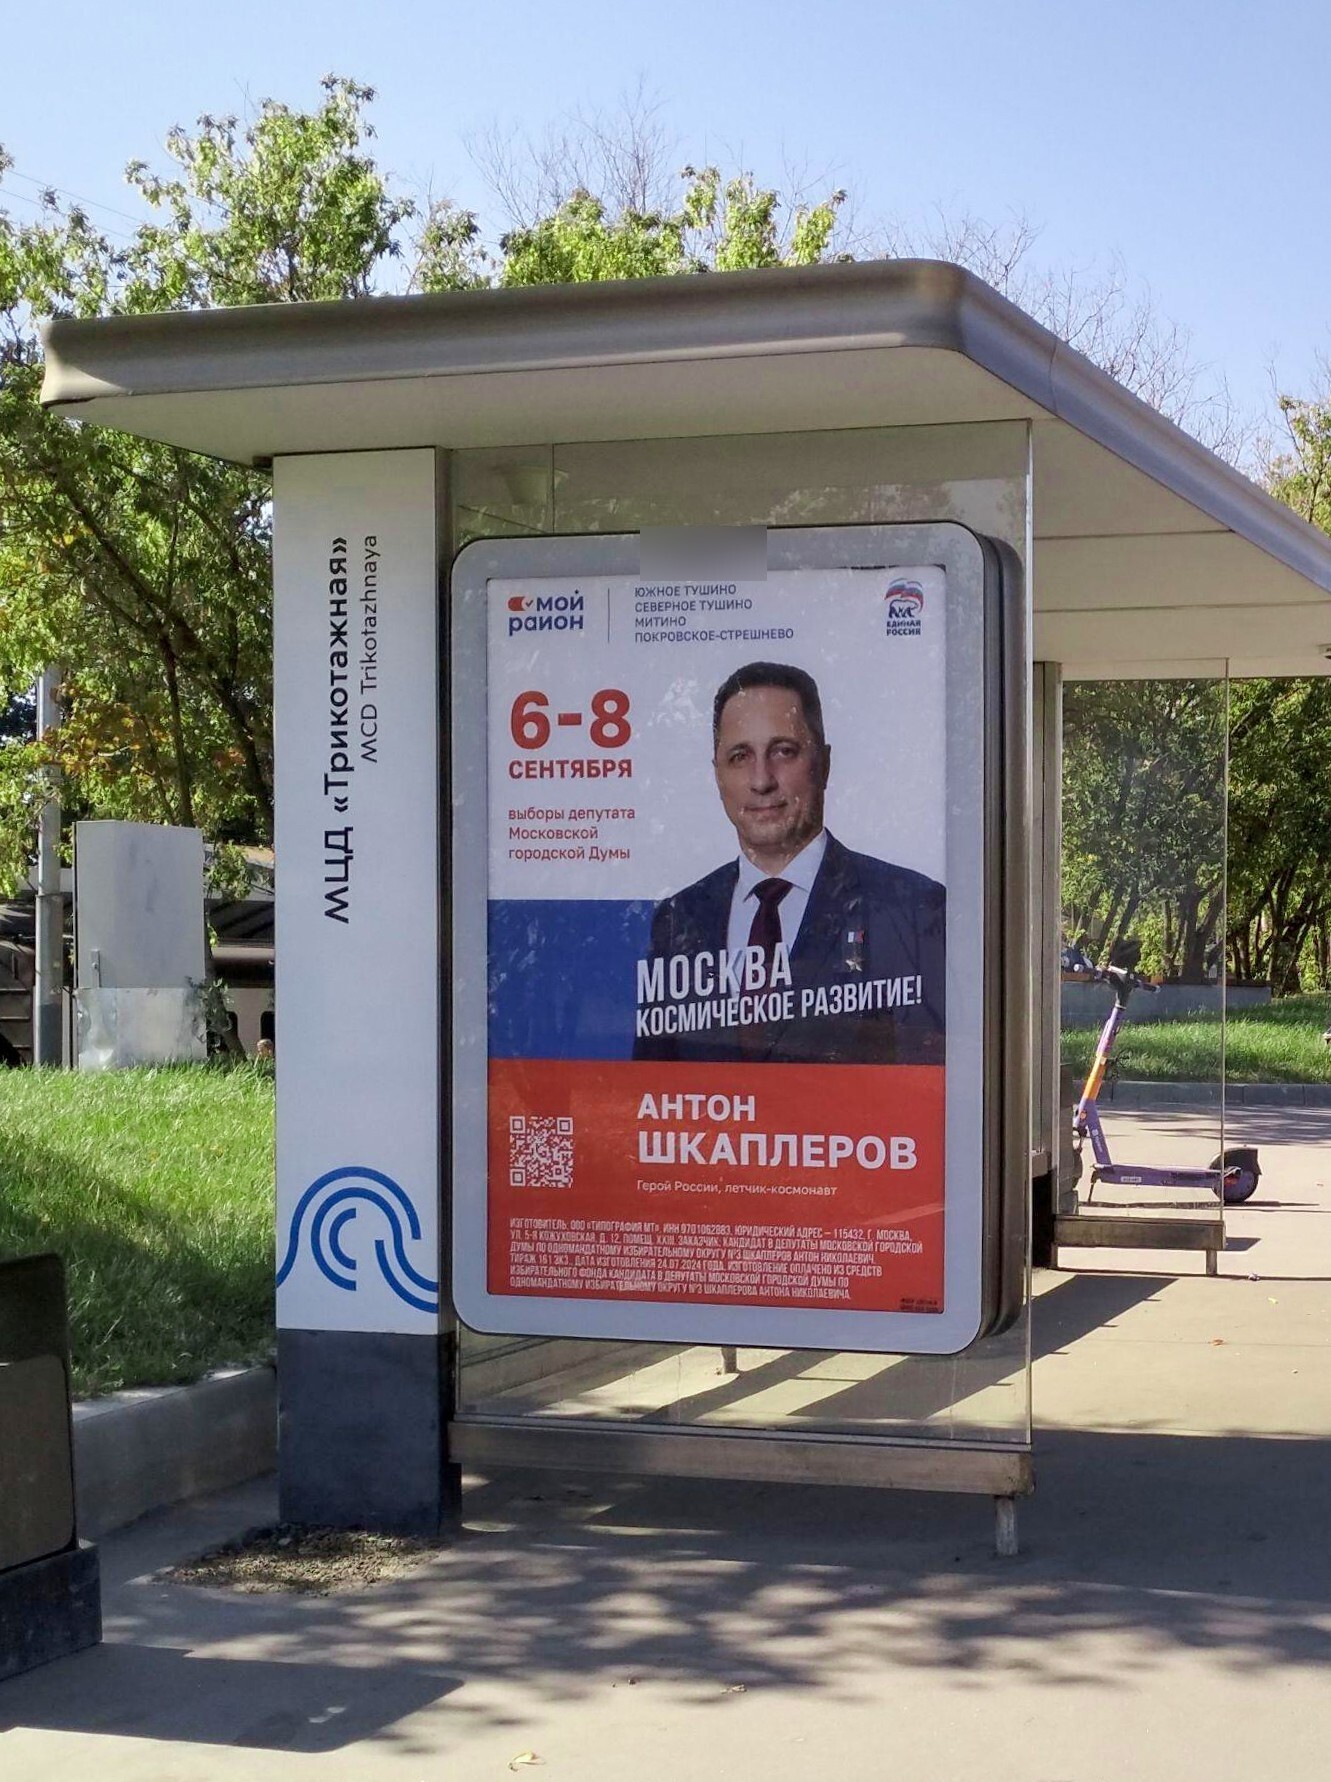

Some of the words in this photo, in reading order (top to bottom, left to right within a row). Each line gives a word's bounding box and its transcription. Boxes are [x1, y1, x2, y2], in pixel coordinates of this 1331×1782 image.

[634, 584, 681, 598] ЮЖНОЕ
[685, 583, 737, 596] ТУШИНО
[634, 600, 696, 613] СЕВЕРНОЕ
[700, 598, 753, 611] ТУШИНО
[360, 535, 382, 694] Trikotazhnaya
[634, 615, 686, 628] МИТИНО
[886, 620, 921, 628] ЕДИНАЯ
[886, 628, 921, 636] РОССИЯ
[634, 628, 794, 643] ПОКРОВСКОЕ-СТРЕШНЕВО
[324, 536, 355, 813] «Трикотажная»
[361, 704, 378, 763] MCD
[509, 759, 632, 779] СЕНТЯБРЯ
[508, 807, 564, 822] выборы
[568, 807, 636, 822] депутата
[508, 826, 599, 840] Московской
[508, 846, 585, 862] городской
[588, 846, 630, 862] Думы
[324, 827, 354, 923] МЦД
[636, 941, 793, 1005] МОСКВА
[636, 990, 795, 1037] КОСМИЧЕСКОЕ
[801, 975, 923, 1018] РАЗВИТИЕ!
[637, 1093, 756, 1122] АНТОН
[637, 1130, 918, 1170] ШКАПЛЕРОВ
[637, 1179, 672, 1193] Герой
[674, 1180, 723, 1195] России,
[724, 1184, 838, 1197] летчик-космонавт
[734, 1224, 795, 1237] ЮРИДИЧЕСКИЙ
[796, 1226, 823, 1239] АДРЕС
[846, 1265, 882, 1277] СРЕДСТВ
